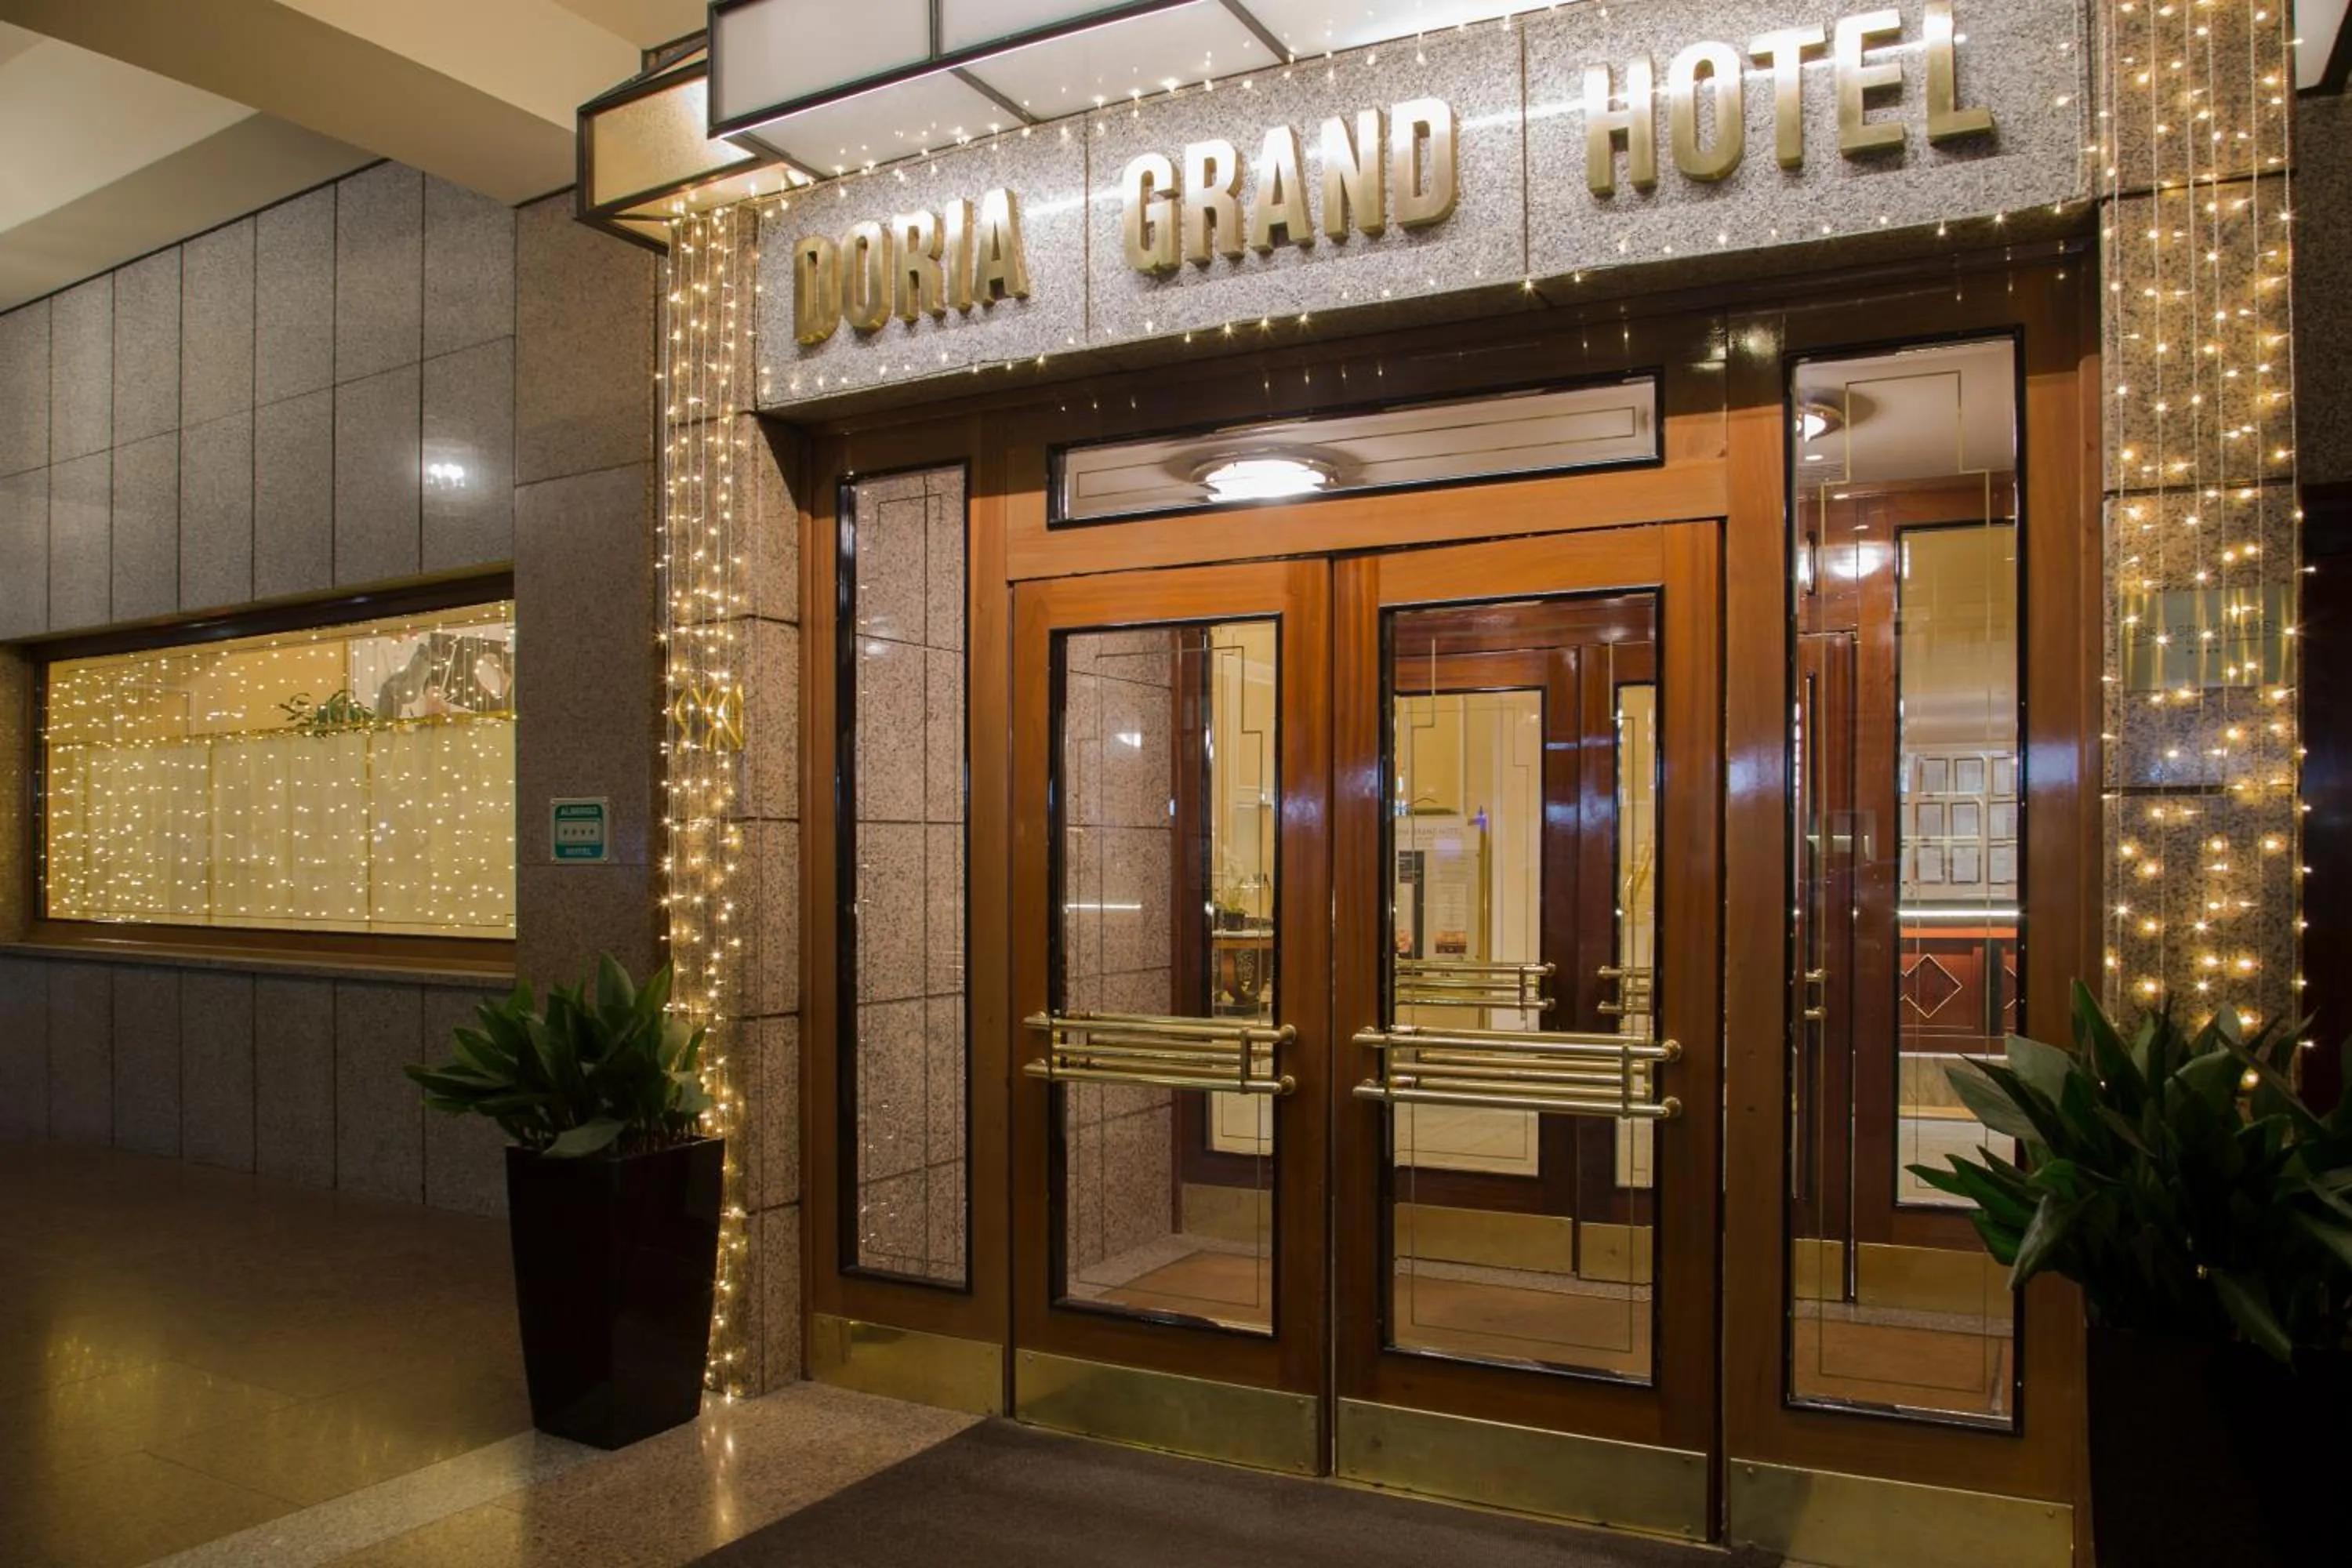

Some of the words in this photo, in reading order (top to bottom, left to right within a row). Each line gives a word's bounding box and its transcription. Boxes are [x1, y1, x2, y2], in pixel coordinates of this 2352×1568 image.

[793, 187, 1029, 345] DORIA
[1123, 96, 1459, 274] GRAND
[1584, 0, 1994, 197] HOTEL
